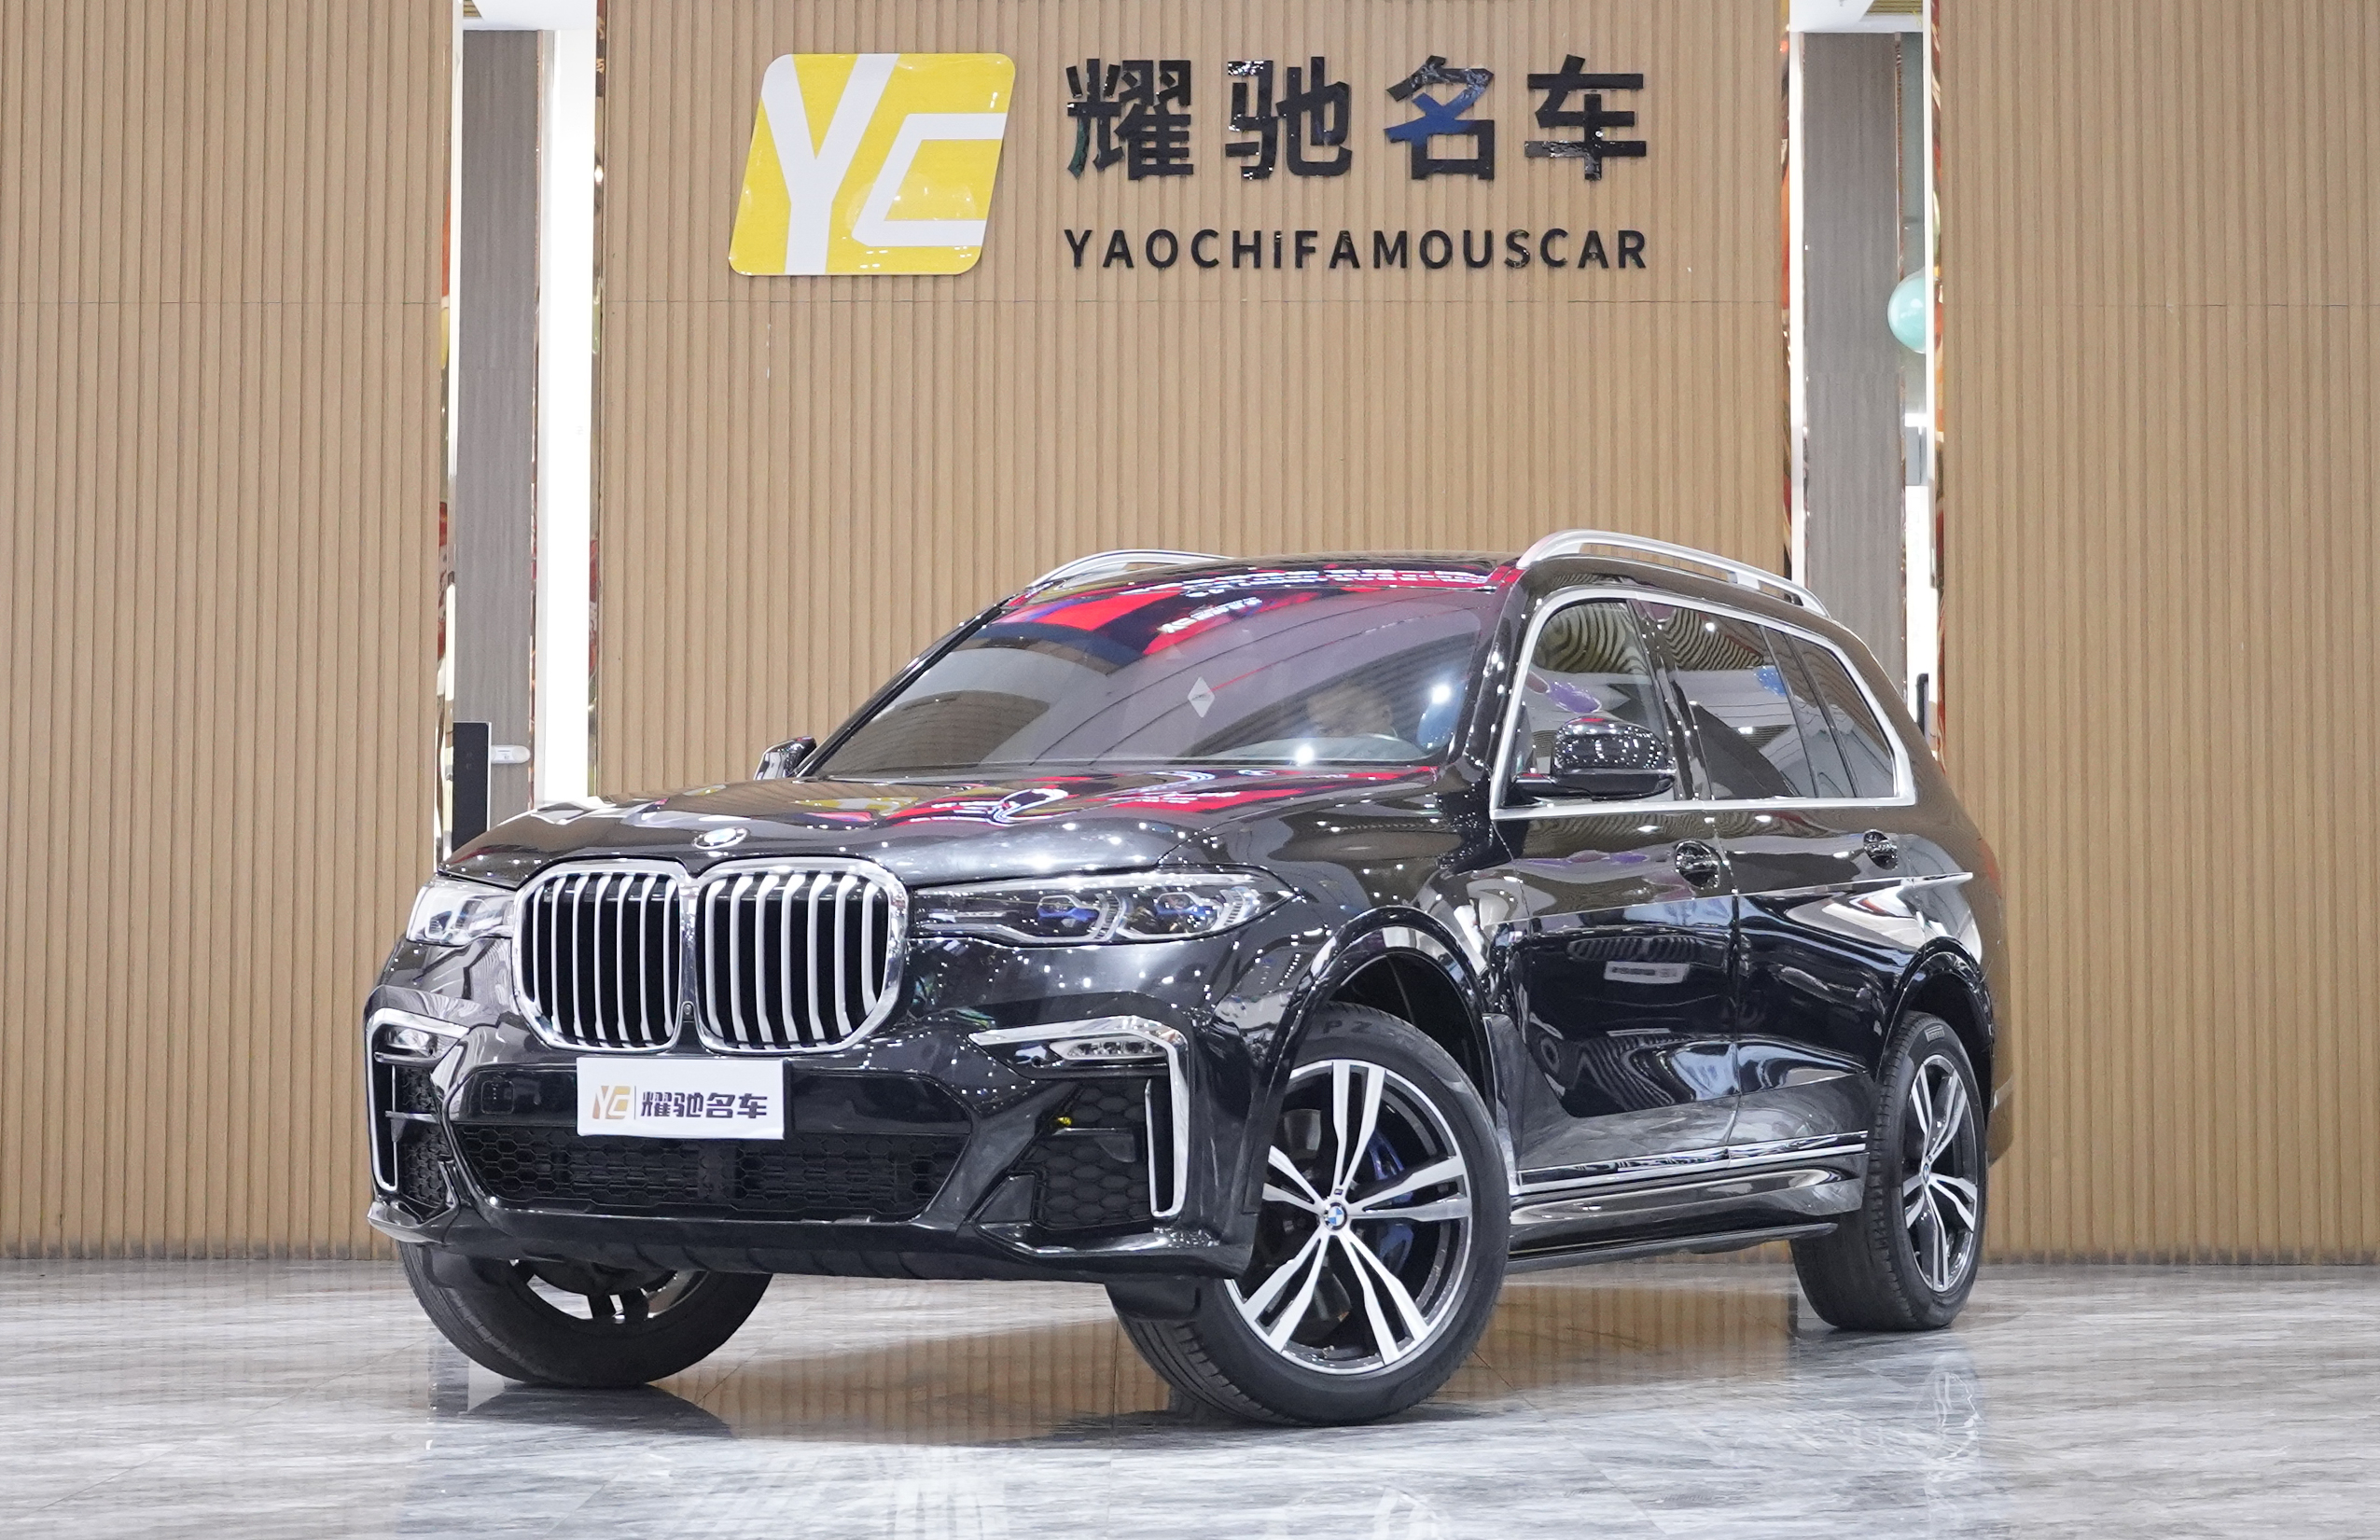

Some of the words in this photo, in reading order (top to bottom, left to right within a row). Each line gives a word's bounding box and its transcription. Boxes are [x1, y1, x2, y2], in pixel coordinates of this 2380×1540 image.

[1065, 54, 1647, 182] 耀驰名车
[640, 1090, 769, 1119] 耀驰名车
